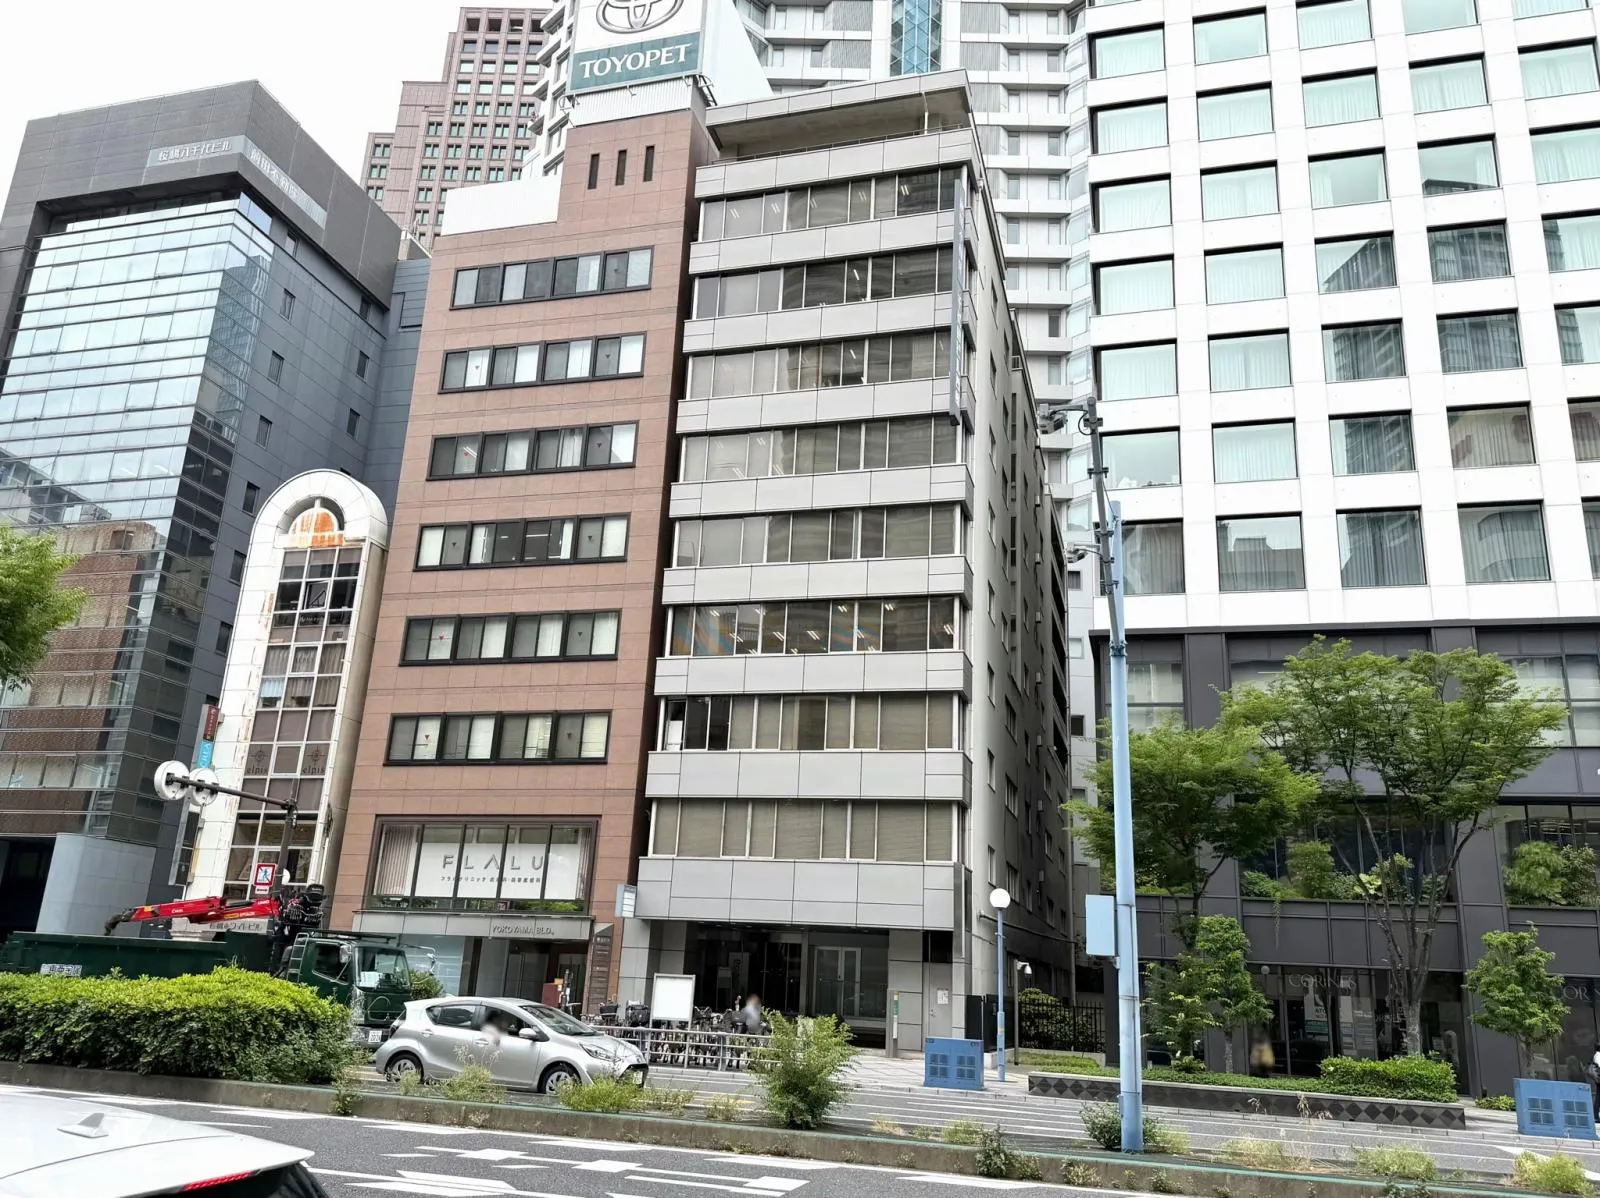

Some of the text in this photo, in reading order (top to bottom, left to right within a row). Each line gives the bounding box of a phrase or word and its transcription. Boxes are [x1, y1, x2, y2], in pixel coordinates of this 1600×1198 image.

[579, 43, 692, 79] TOYOPET
[246, 764, 269, 775] elpis
[302, 765, 325, 776] elpis
[442, 854, 544, 871] FLALU
